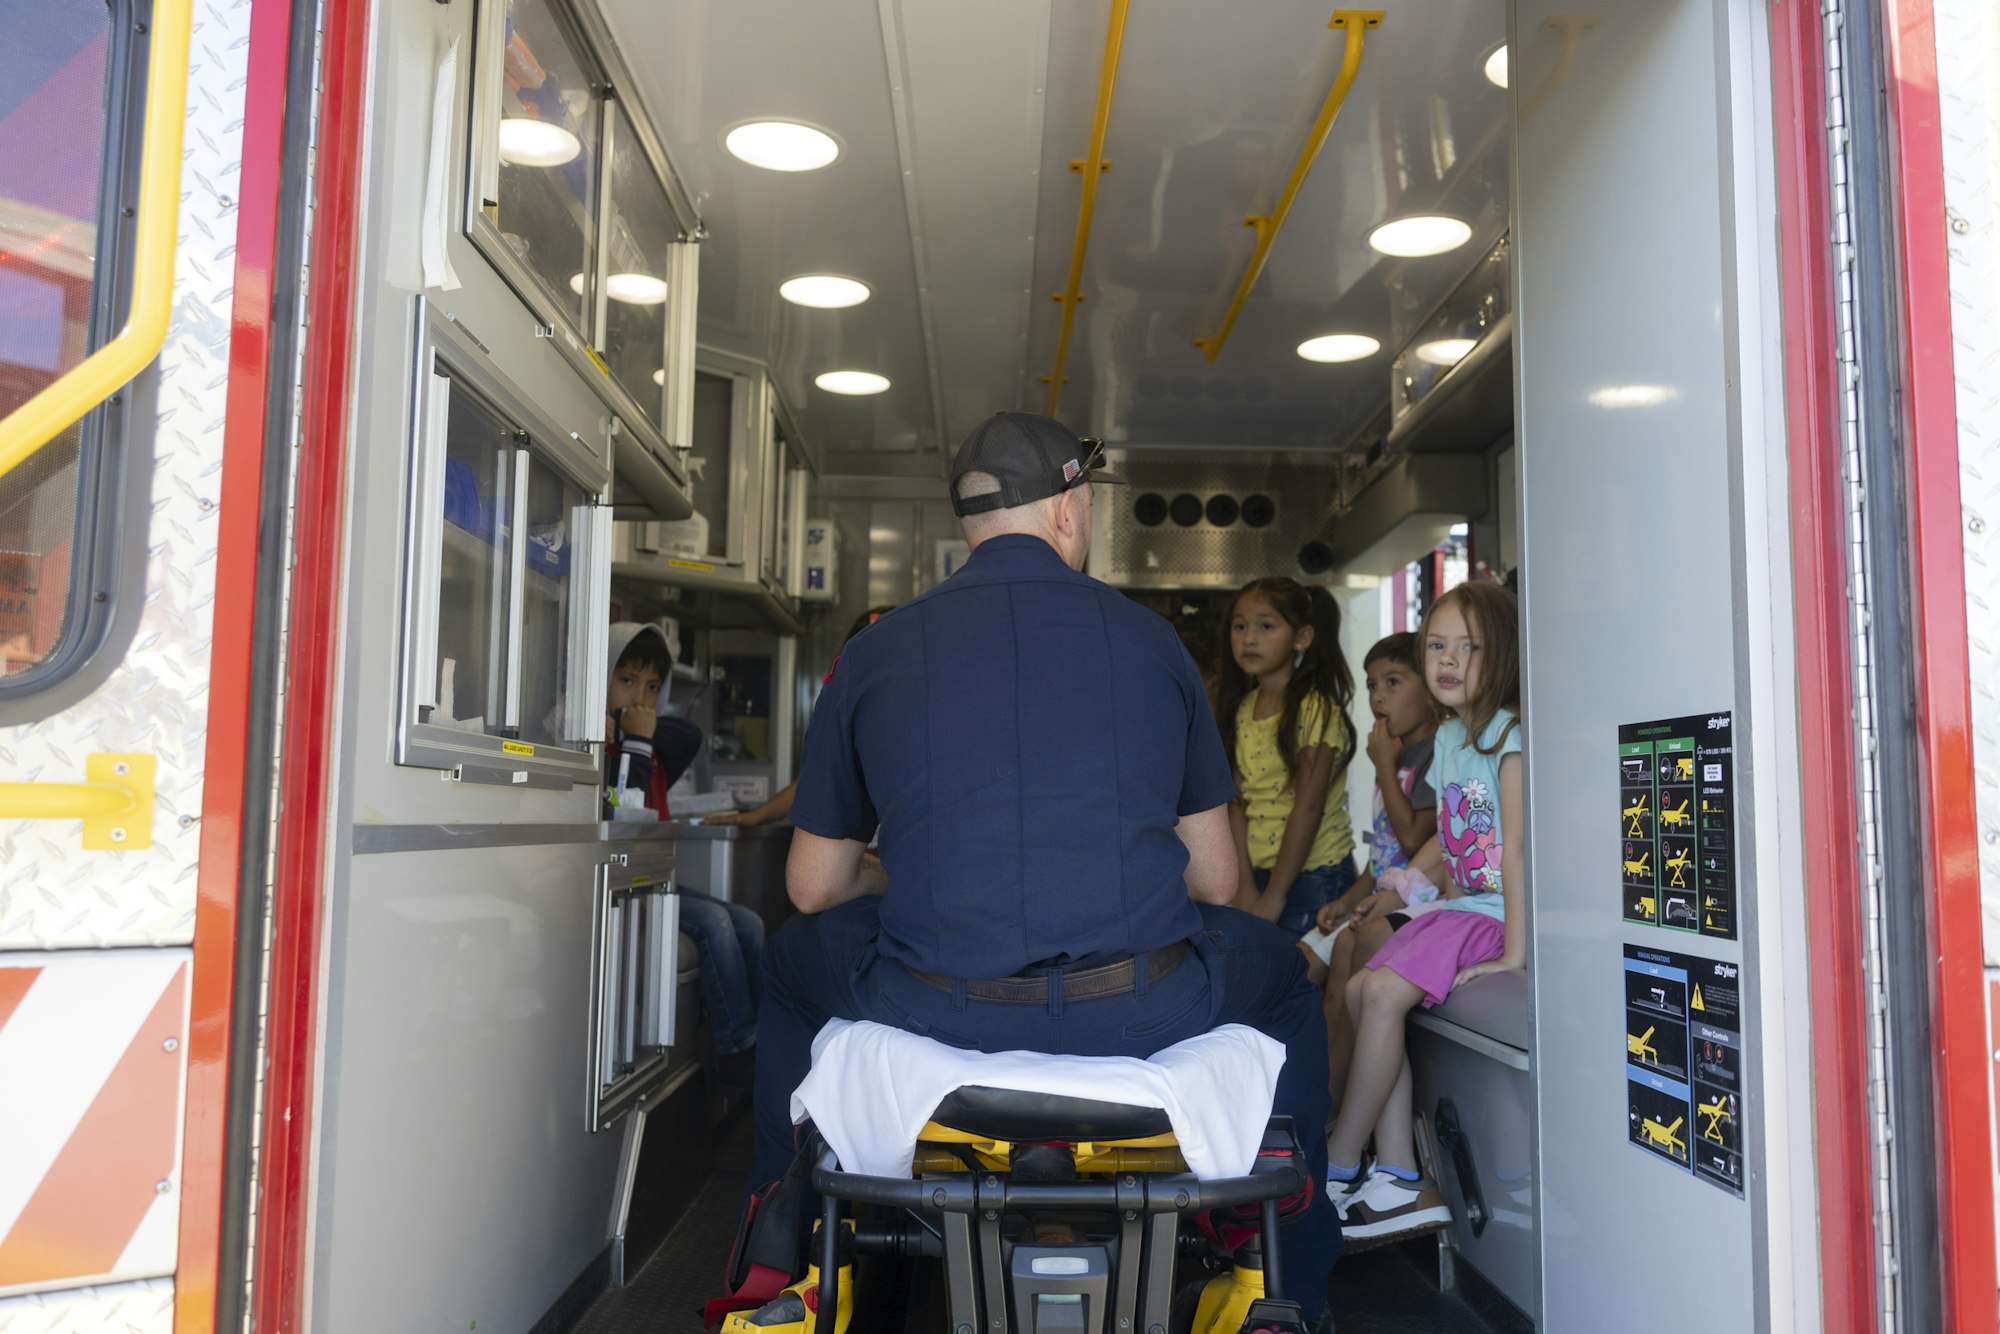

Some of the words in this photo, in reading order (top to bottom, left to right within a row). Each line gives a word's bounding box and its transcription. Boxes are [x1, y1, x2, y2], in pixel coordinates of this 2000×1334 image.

[1707, 716, 1730, 730] stryker
[1714, 963, 1737, 978] stryker
[1701, 1027, 1713, 1037] Other
[1712, 1030, 1729, 1042] Controls
